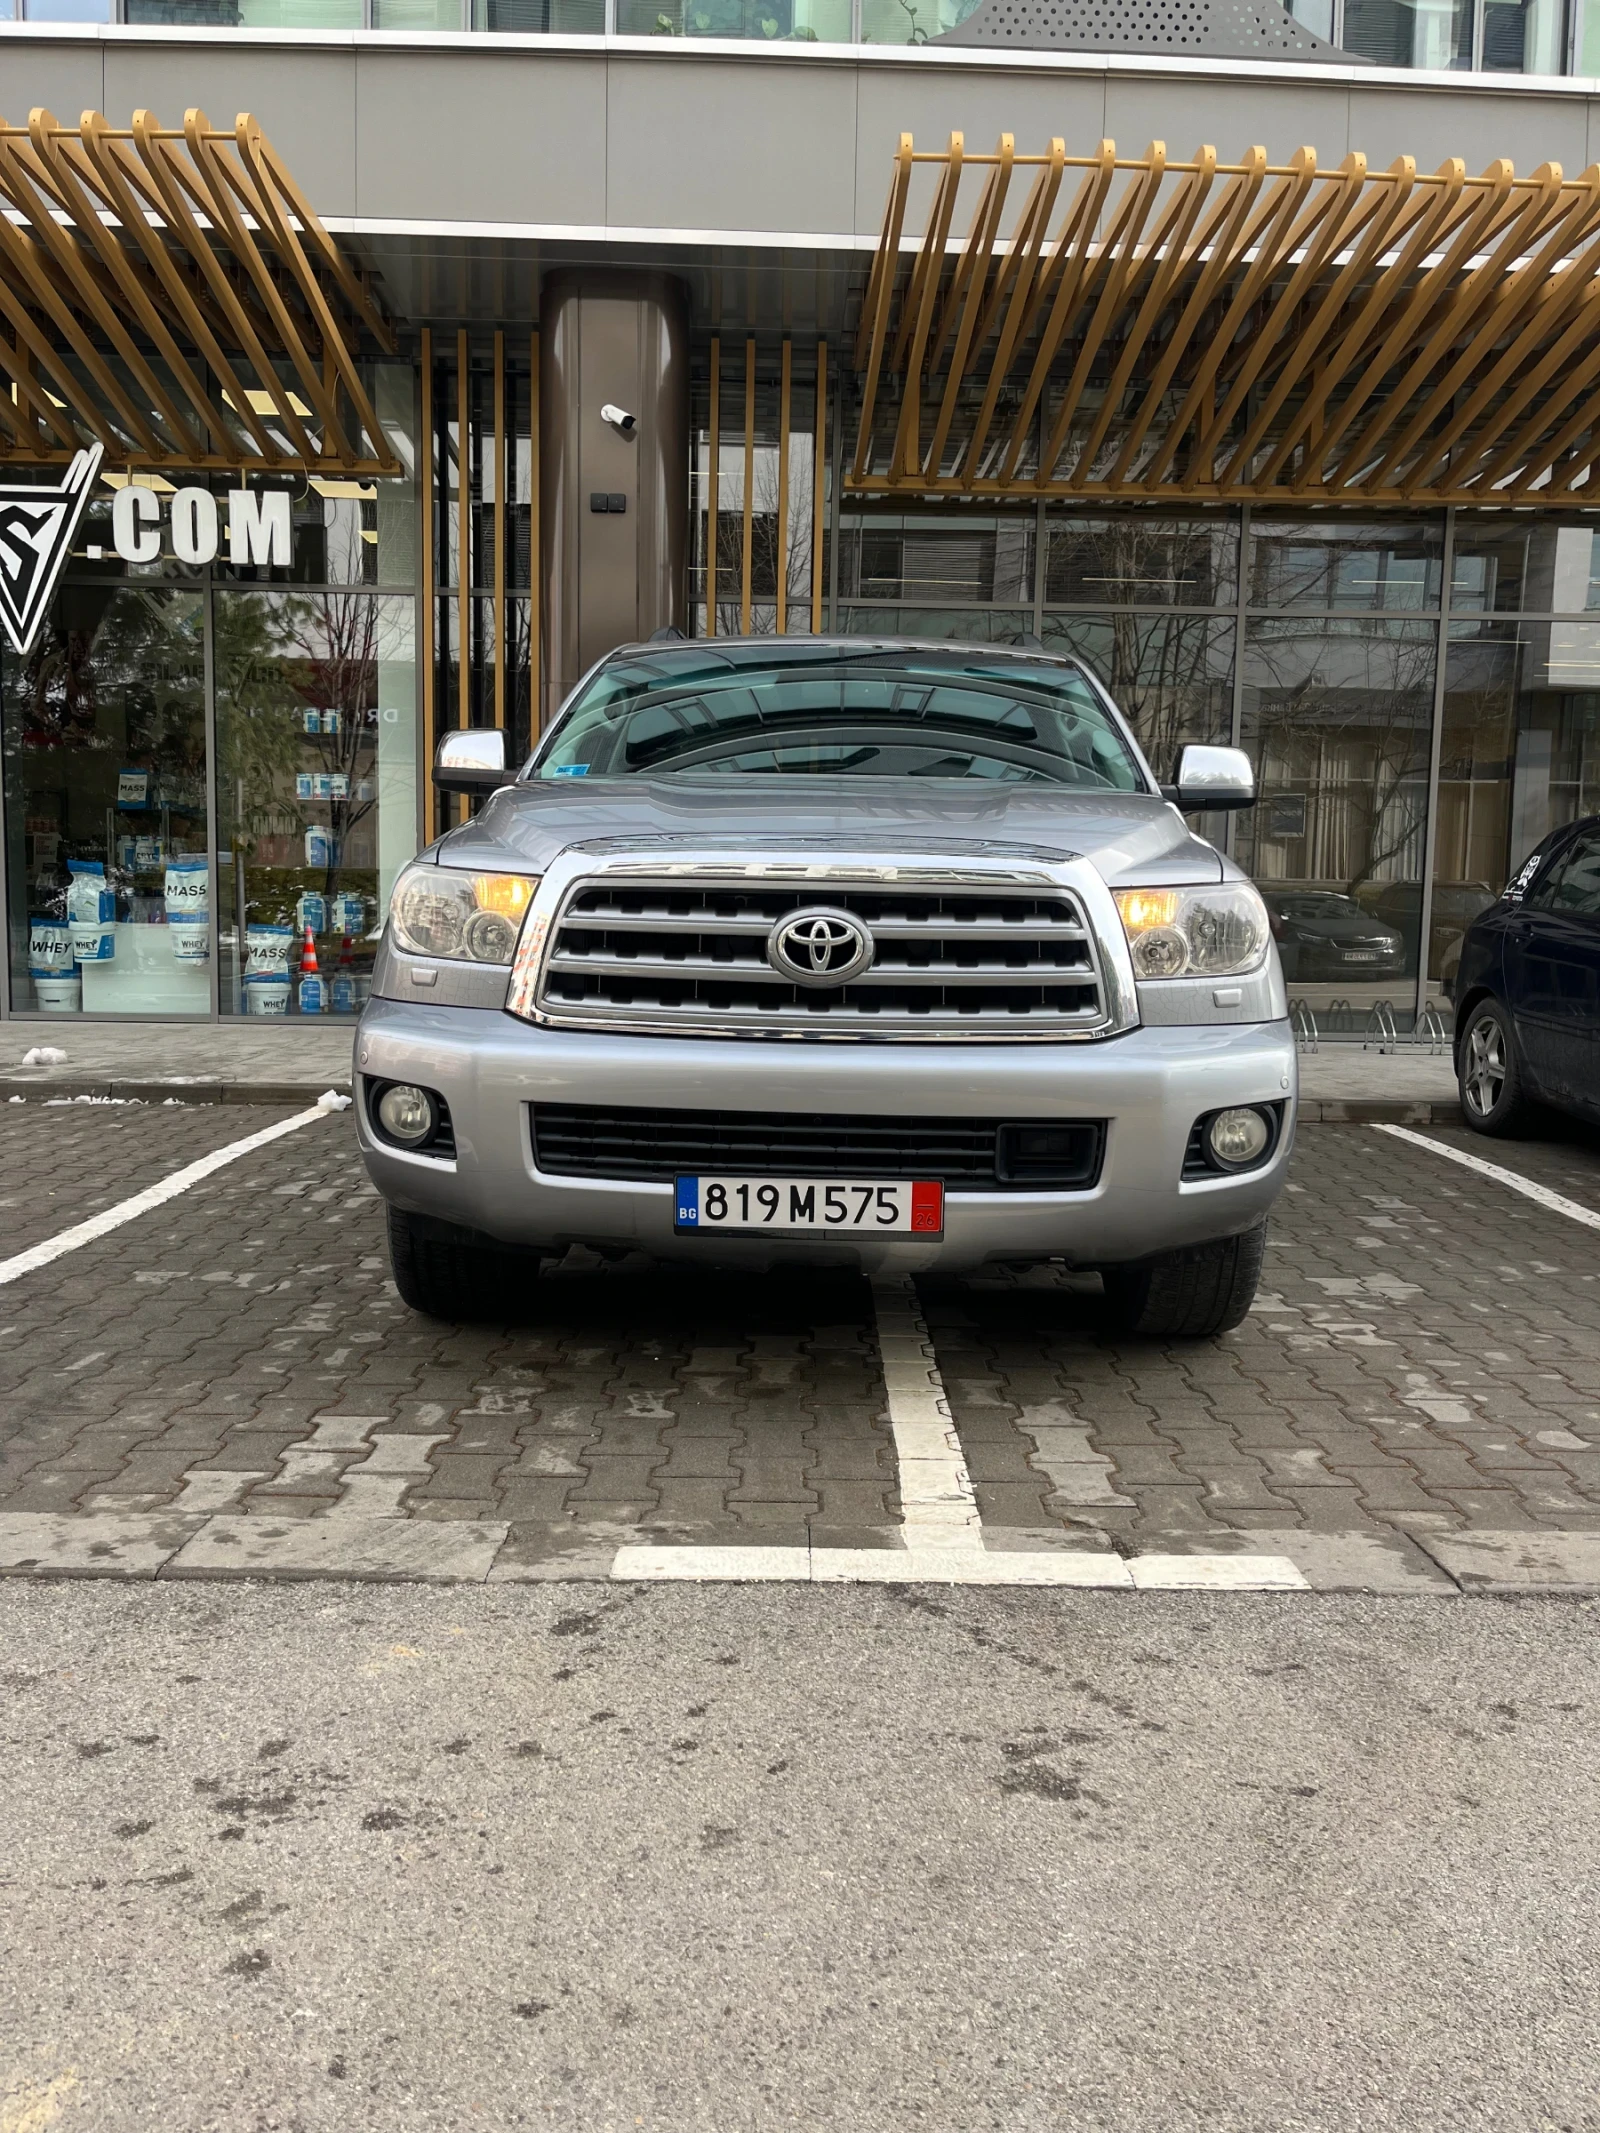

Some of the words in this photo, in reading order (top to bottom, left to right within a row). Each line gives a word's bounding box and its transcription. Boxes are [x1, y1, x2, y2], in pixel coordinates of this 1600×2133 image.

[120, 784, 145, 792] MASS
[166, 884, 207, 897] MASS
[31, 941, 72, 954] WHEY
[75, 940, 96, 950] WHEY
[181, 939, 204, 949] WHEY
[249, 946, 287, 958] MASS
[263, 1000, 284, 1008] WHEY
[679, 1207, 697, 1219] BG
[915, 1212, 935, 1227] 26
